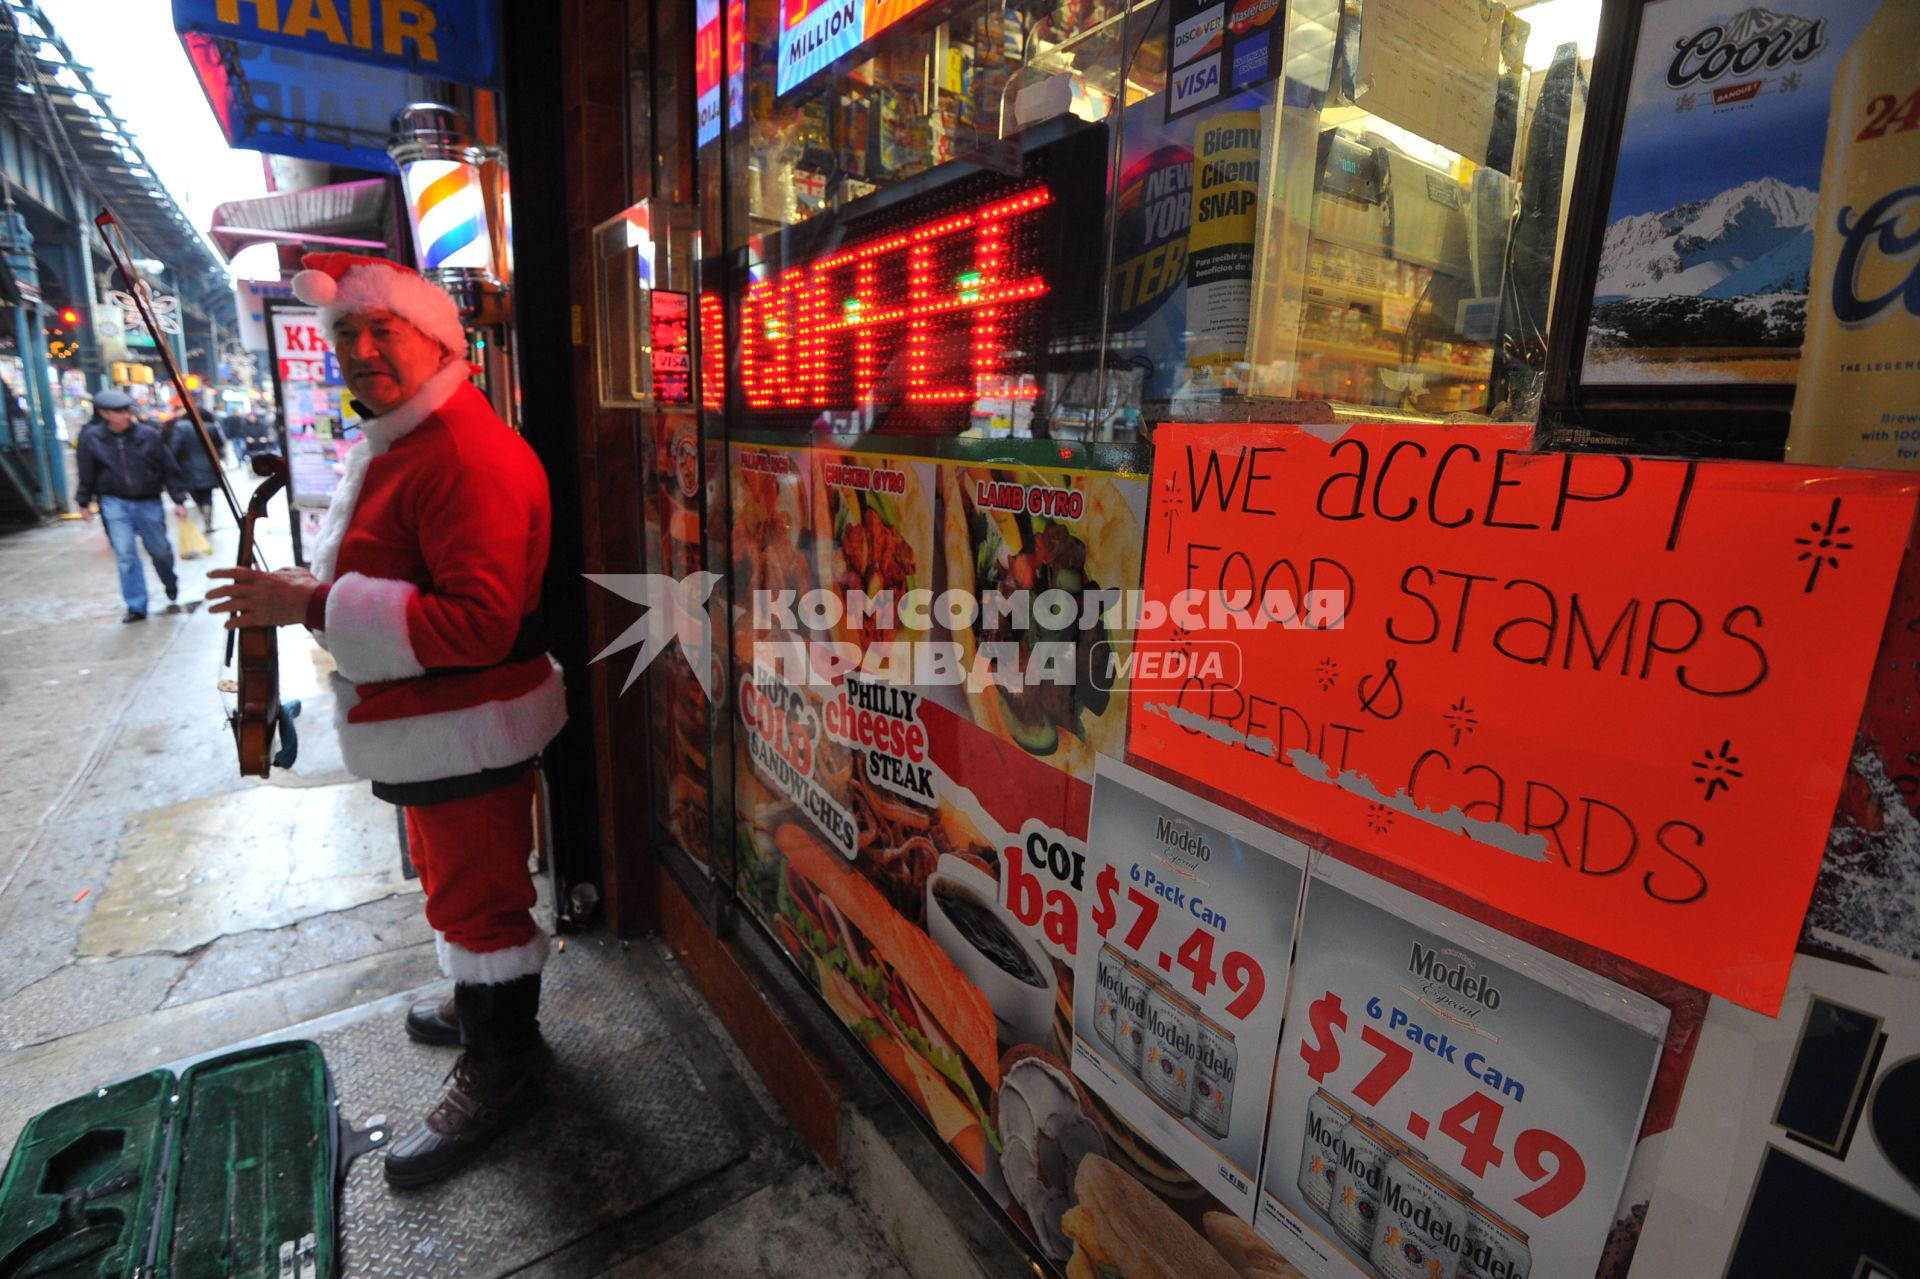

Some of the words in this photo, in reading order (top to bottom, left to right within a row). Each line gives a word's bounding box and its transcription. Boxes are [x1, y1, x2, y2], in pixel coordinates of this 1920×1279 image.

[215, 0, 439, 63] HAIR
[789, 4, 855, 66] MILLION
[1176, 17, 1223, 48] DISCOVER
[1666, 16, 1826, 88] Coors
[1176, 65, 1218, 99] VISA
[1198, 190, 1256, 222] SNAP
[661, 356, 688, 368] VISA
[1840, 362, 1860, 373] THE
[1860, 429, 1889, 441] with
[825, 464, 870, 490] CHICKEN
[872, 470, 906, 494] GYRO
[977, 481, 1024, 511] LAMB
[1028, 487, 1084, 519] GYRO
[1185, 444, 1287, 517] WE
[1185, 544, 1355, 630] FOOD
[757, 666, 789, 710] HOT
[846, 677, 917, 722] PHILLY
[1357, 658, 1402, 720] &
[741, 680, 814, 776] COLD
[824, 692, 925, 764] cheese
[1177, 674, 1365, 782] CREDIT
[751, 731, 855, 851] SANDWICHES
[869, 750, 935, 799] STEAK
[1156, 815, 1211, 863] Modelo
[1130, 863, 1140, 882] 6
[1144, 870, 1186, 910] Pack
[1189, 897, 1228, 933] Can
[1091, 862, 1266, 1021] $7.49
[1408, 941, 1501, 1010] Modelo
[1147, 1005, 1196, 1060] Modelo
[1365, 996, 1383, 1021] 6
[1388, 1007, 1457, 1065] Pack
[1464, 1052, 1527, 1104] Can
[1300, 990, 1587, 1220] $7.49
[1383, 1176, 1461, 1253] Modelo
